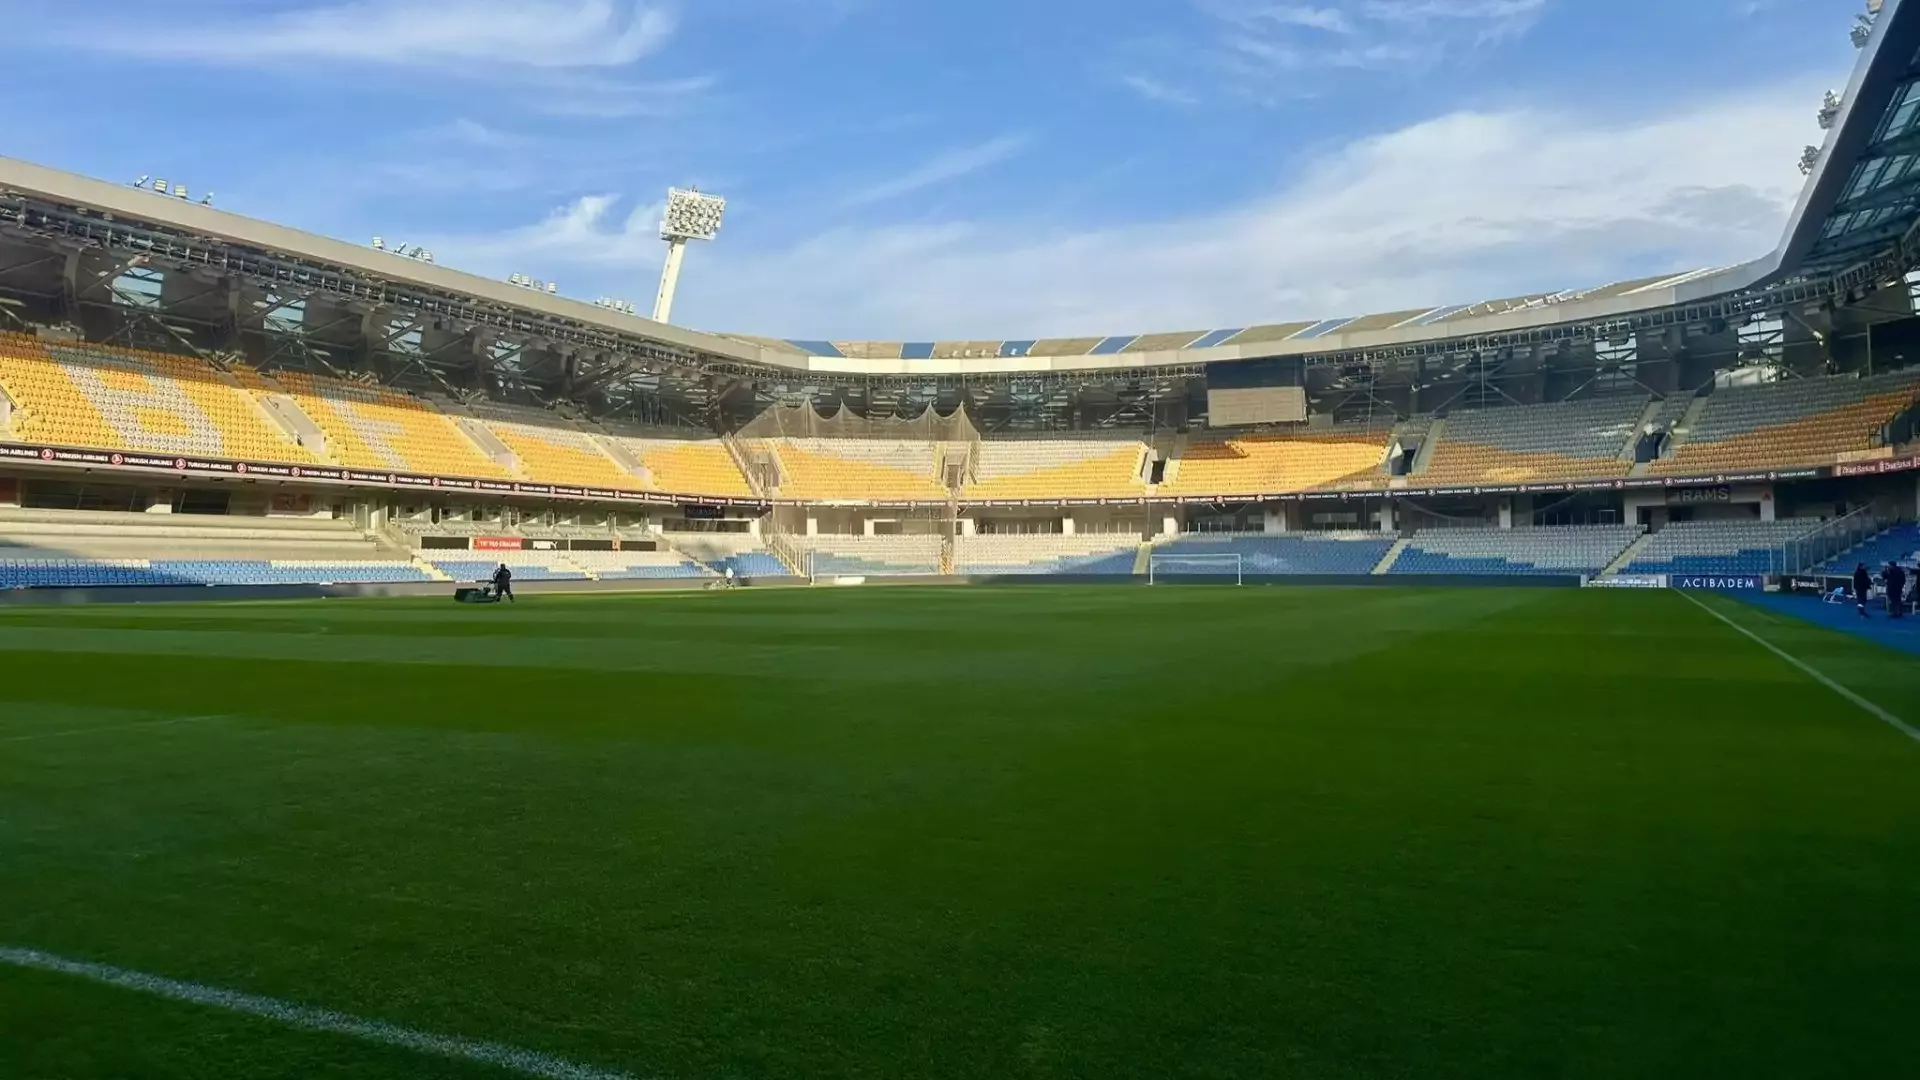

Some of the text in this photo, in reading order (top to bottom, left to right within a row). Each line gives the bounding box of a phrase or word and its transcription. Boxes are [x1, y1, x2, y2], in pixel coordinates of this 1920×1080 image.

[10, 449, 38, 458] AIRLINES
[56, 452, 109, 462] TURKISH AIRLINES
[124, 456, 173, 466] TURKISH AIRLINES
[187, 461, 209, 469] TURKISH
[1682, 488, 1729, 502] RAMS
[1682, 578, 1754, 588] ACIBADEM
